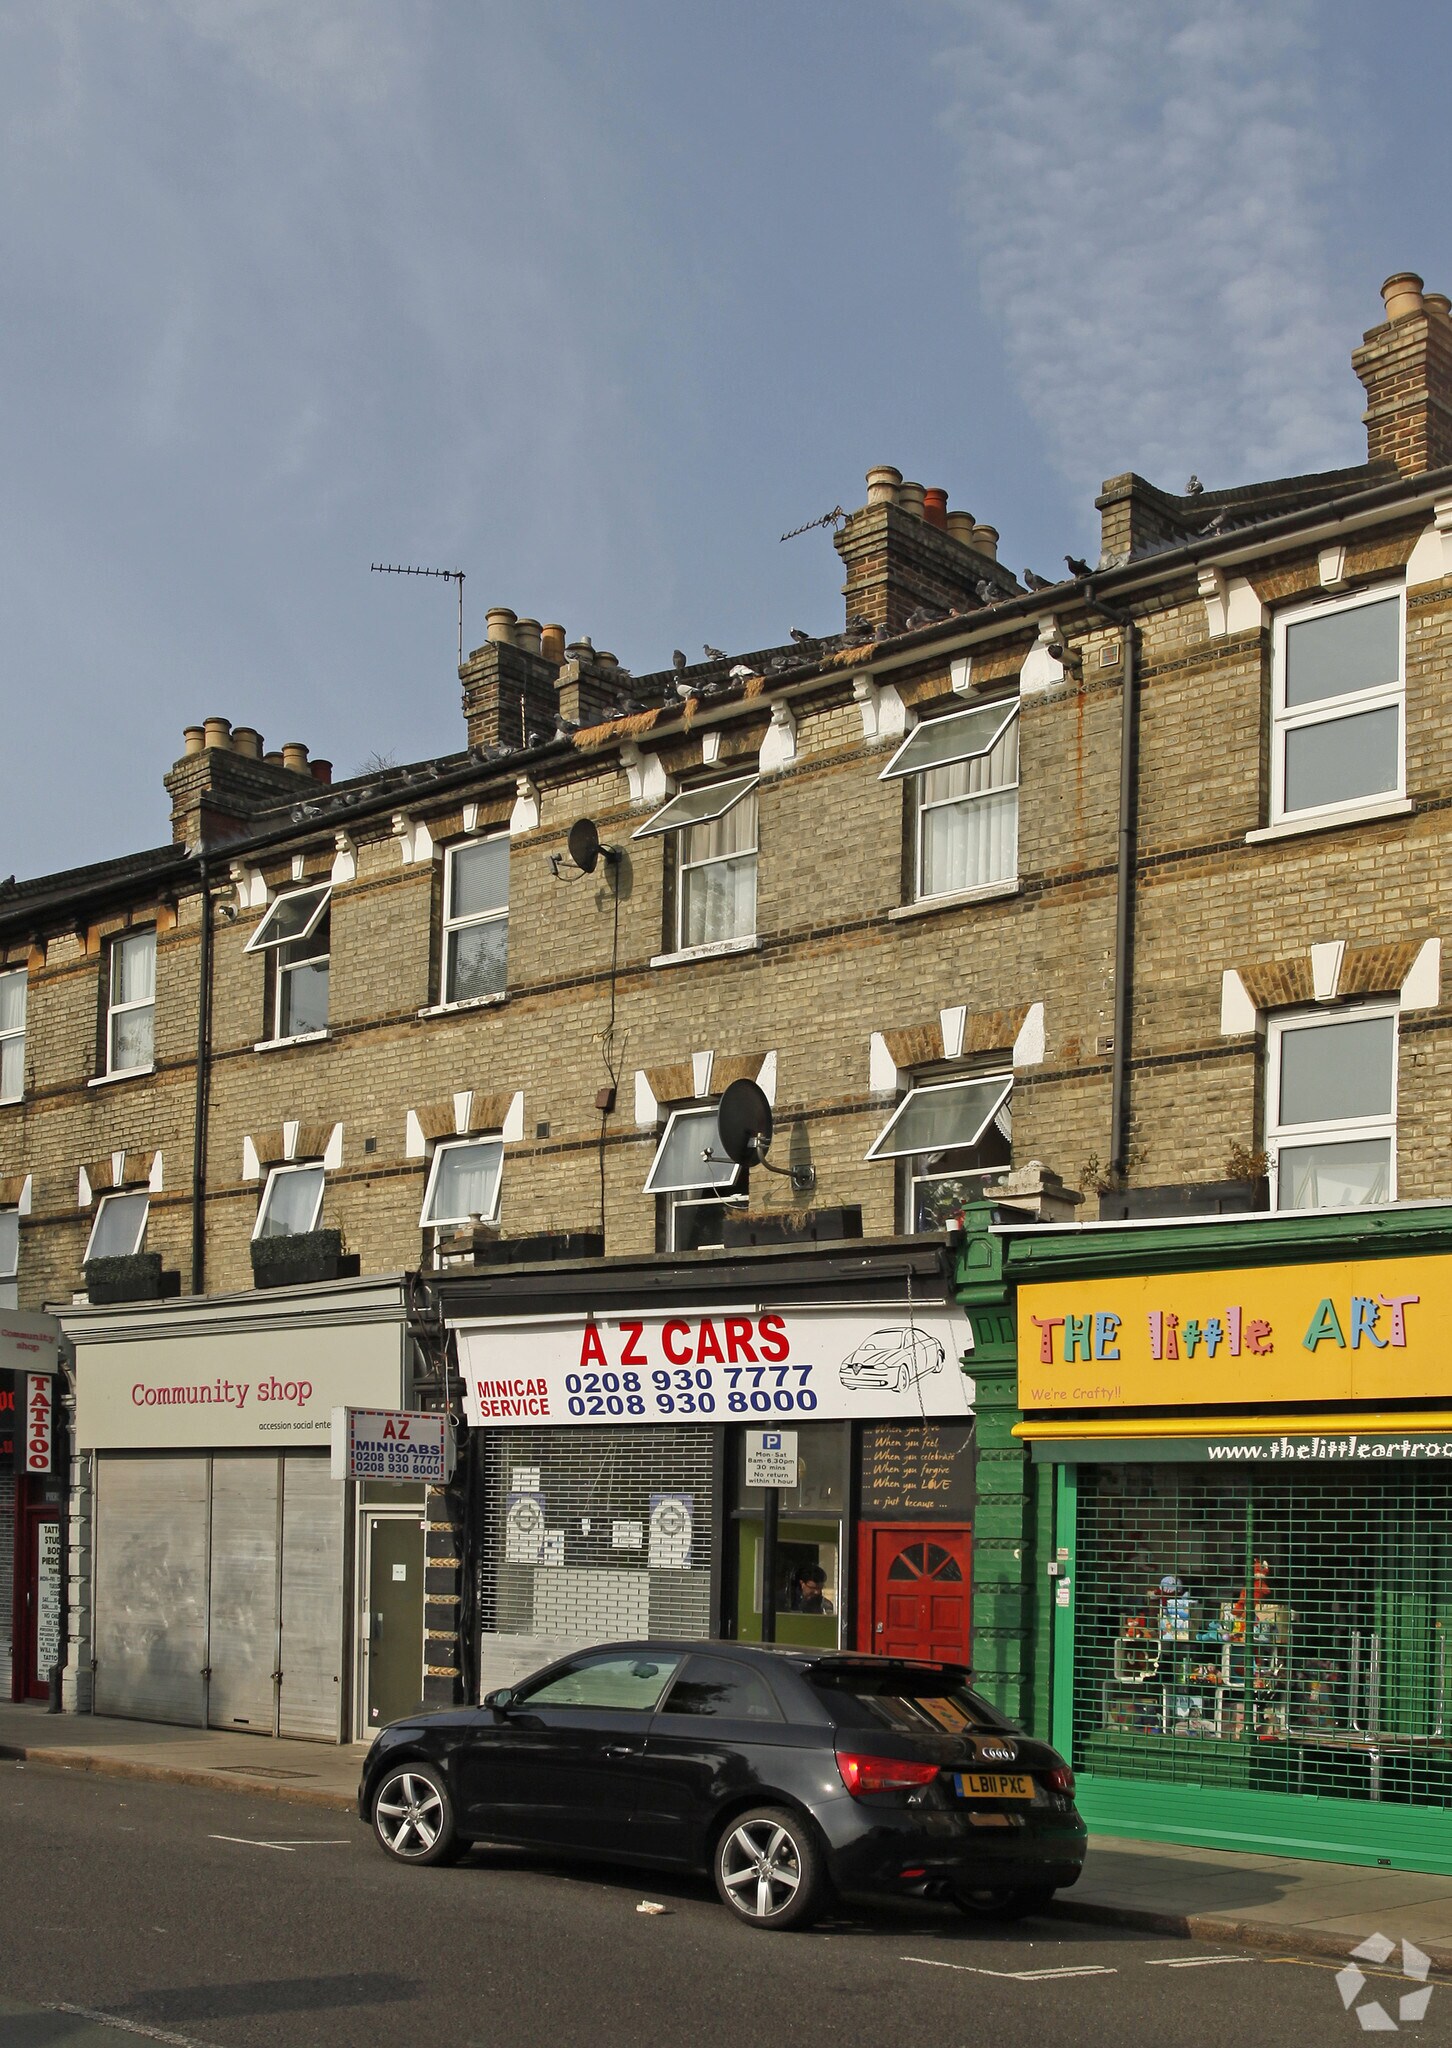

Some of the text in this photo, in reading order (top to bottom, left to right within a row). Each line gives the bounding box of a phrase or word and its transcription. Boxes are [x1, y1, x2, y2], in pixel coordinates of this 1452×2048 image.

[1, 1329, 55, 1344] Community
[1030, 1293, 1420, 1364] THE little ART
[16, 1341, 40, 1352] shop
[579, 1314, 790, 1366] A Z CARS
[477, 1378, 548, 1398] MINICAB
[565, 1364, 813, 1394] 0208 930 7777
[131, 1376, 312, 1409] Community shop
[1031, 1386, 1121, 1401] We're Crafty!!
[480, 1398, 550, 1417] SERVICE
[568, 1389, 818, 1416] 0208 930 8000
[29, 1376, 51, 1469] TATTOO
[259, 1421, 292, 1431] accession
[293, 1421, 313, 1429] social
[383, 1419, 411, 1440] AZ
[356, 1441, 440, 1455] MINICABS
[766, 1435, 778, 1449] P
[875, 1435, 902, 1447] When
[904, 1438, 919, 1451] you
[921, 1436, 939, 1450] feel
[356, 1452, 440, 1465] 0208 930 7777
[873, 1448, 900, 1461] When
[902, 1454, 918, 1466] you
[356, 1462, 440, 1474] 0208 930 8000
[873, 1461, 900, 1474] When
[902, 1466, 918, 1479] you
[920, 1462, 950, 1478] forgive
[873, 1475, 900, 1488] When
[901, 1482, 917, 1494] you
[921, 1479, 952, 1490] LOVE
[904, 1495, 934, 1508] because
[907, 1795, 921, 1803] A1
